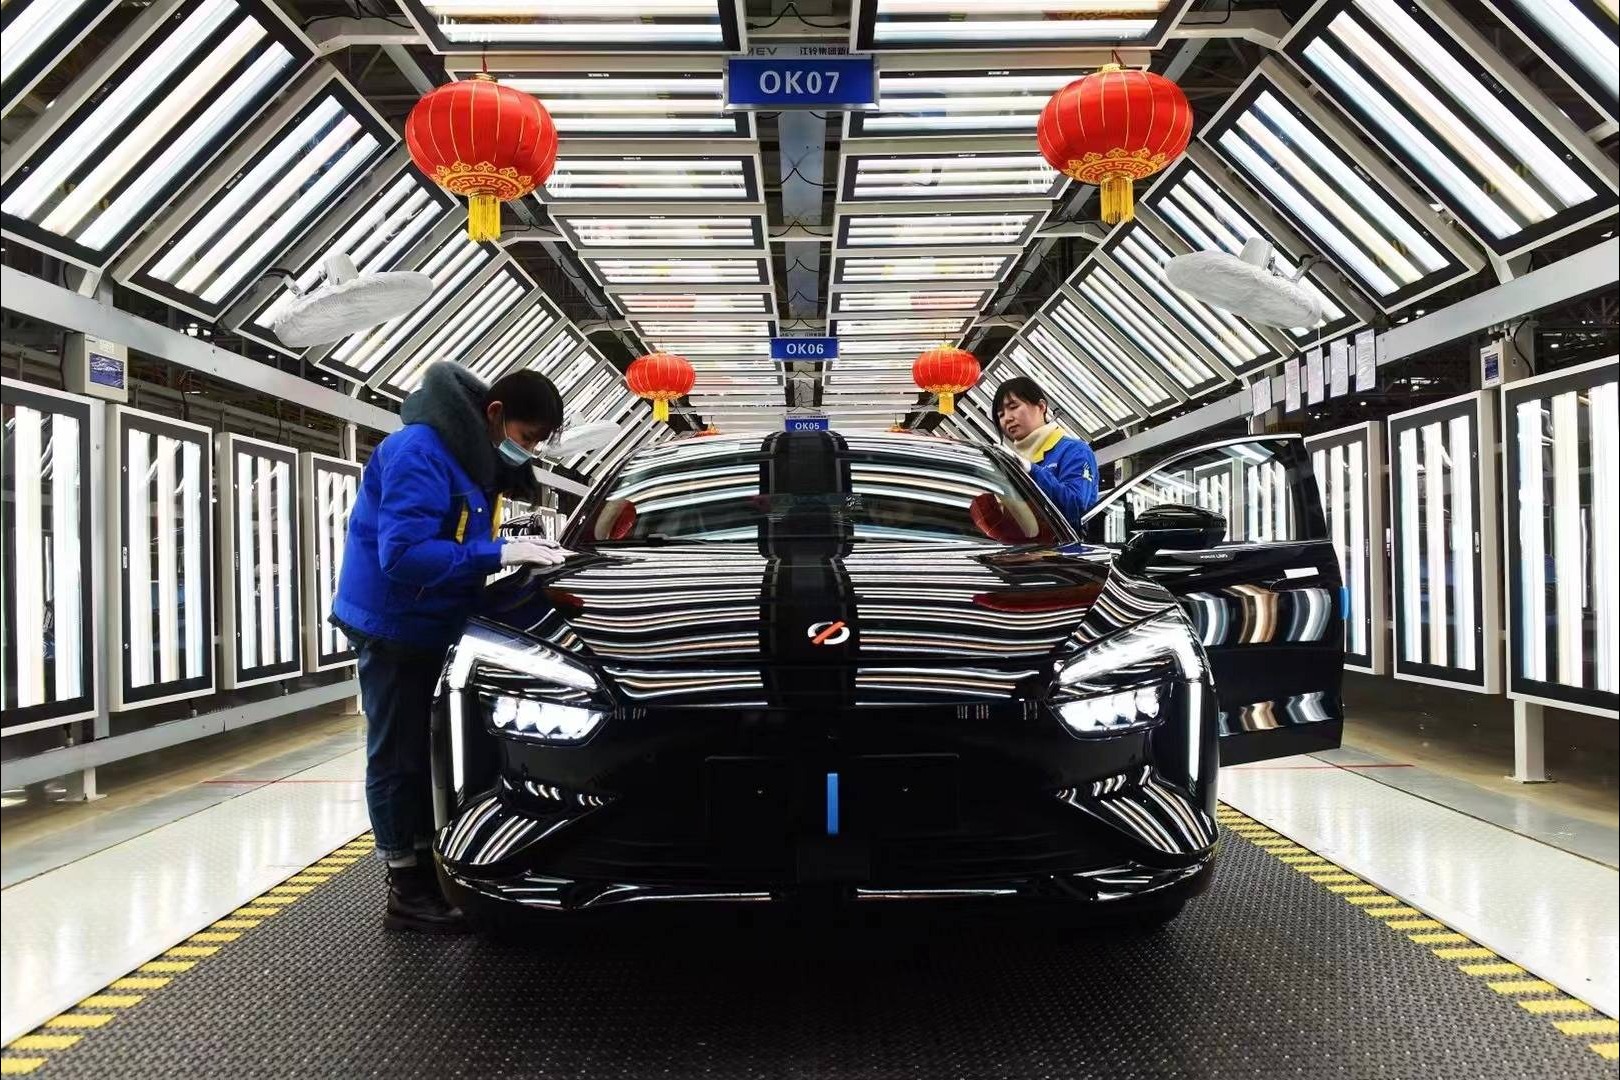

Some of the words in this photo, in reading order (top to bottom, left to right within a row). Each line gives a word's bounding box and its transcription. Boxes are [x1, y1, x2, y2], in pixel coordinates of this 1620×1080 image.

[759, 70, 840, 95] OK07
[786, 343, 825, 355] OK06
[795, 422, 820, 430] OK05
